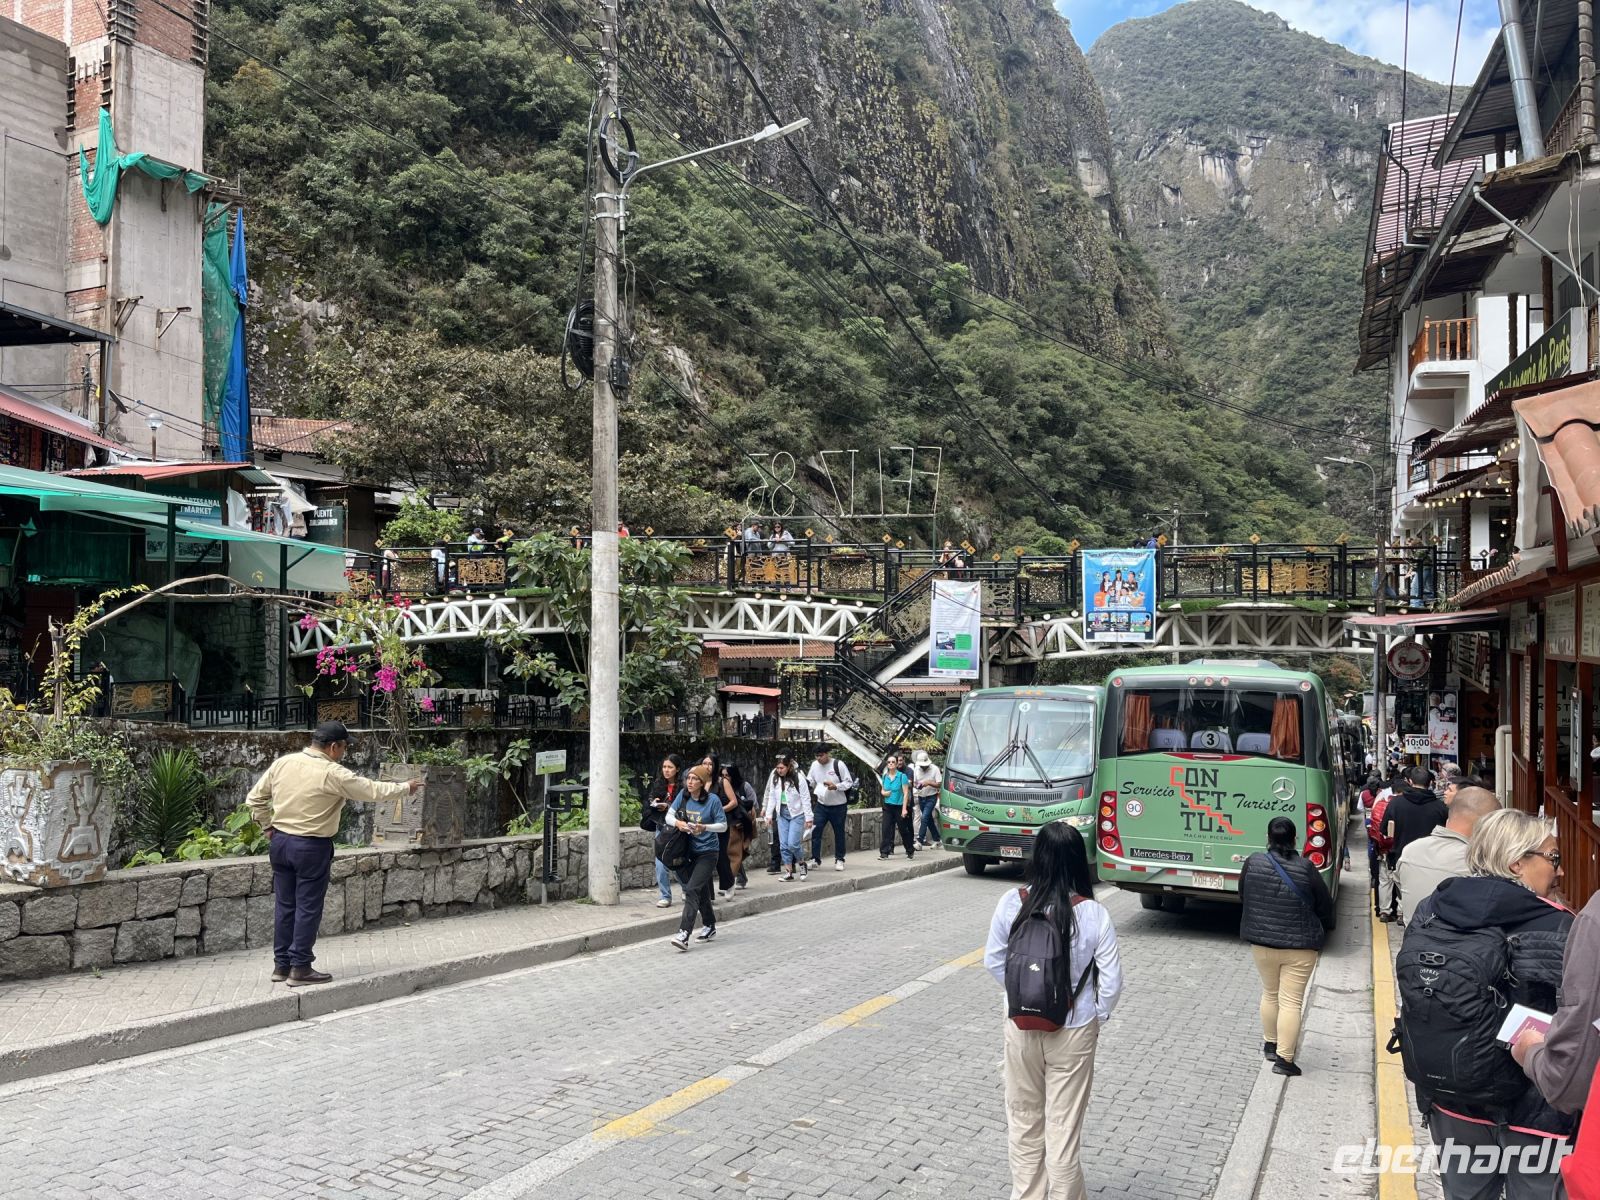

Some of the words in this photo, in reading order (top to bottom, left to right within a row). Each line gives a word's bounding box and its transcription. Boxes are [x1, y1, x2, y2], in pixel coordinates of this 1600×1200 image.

[184, 506, 212, 515] MARKET
[313, 509, 333, 518] PUENTE
[1206, 733, 1215, 746] 3
[1406, 738, 1430, 747] 10:00
[1120, 781, 1175, 797] Servicio
[964, 802, 995, 815] Servicio
[1127, 803, 1142, 813] 90
[1133, 848, 1191, 861] Mercedes-Benz
